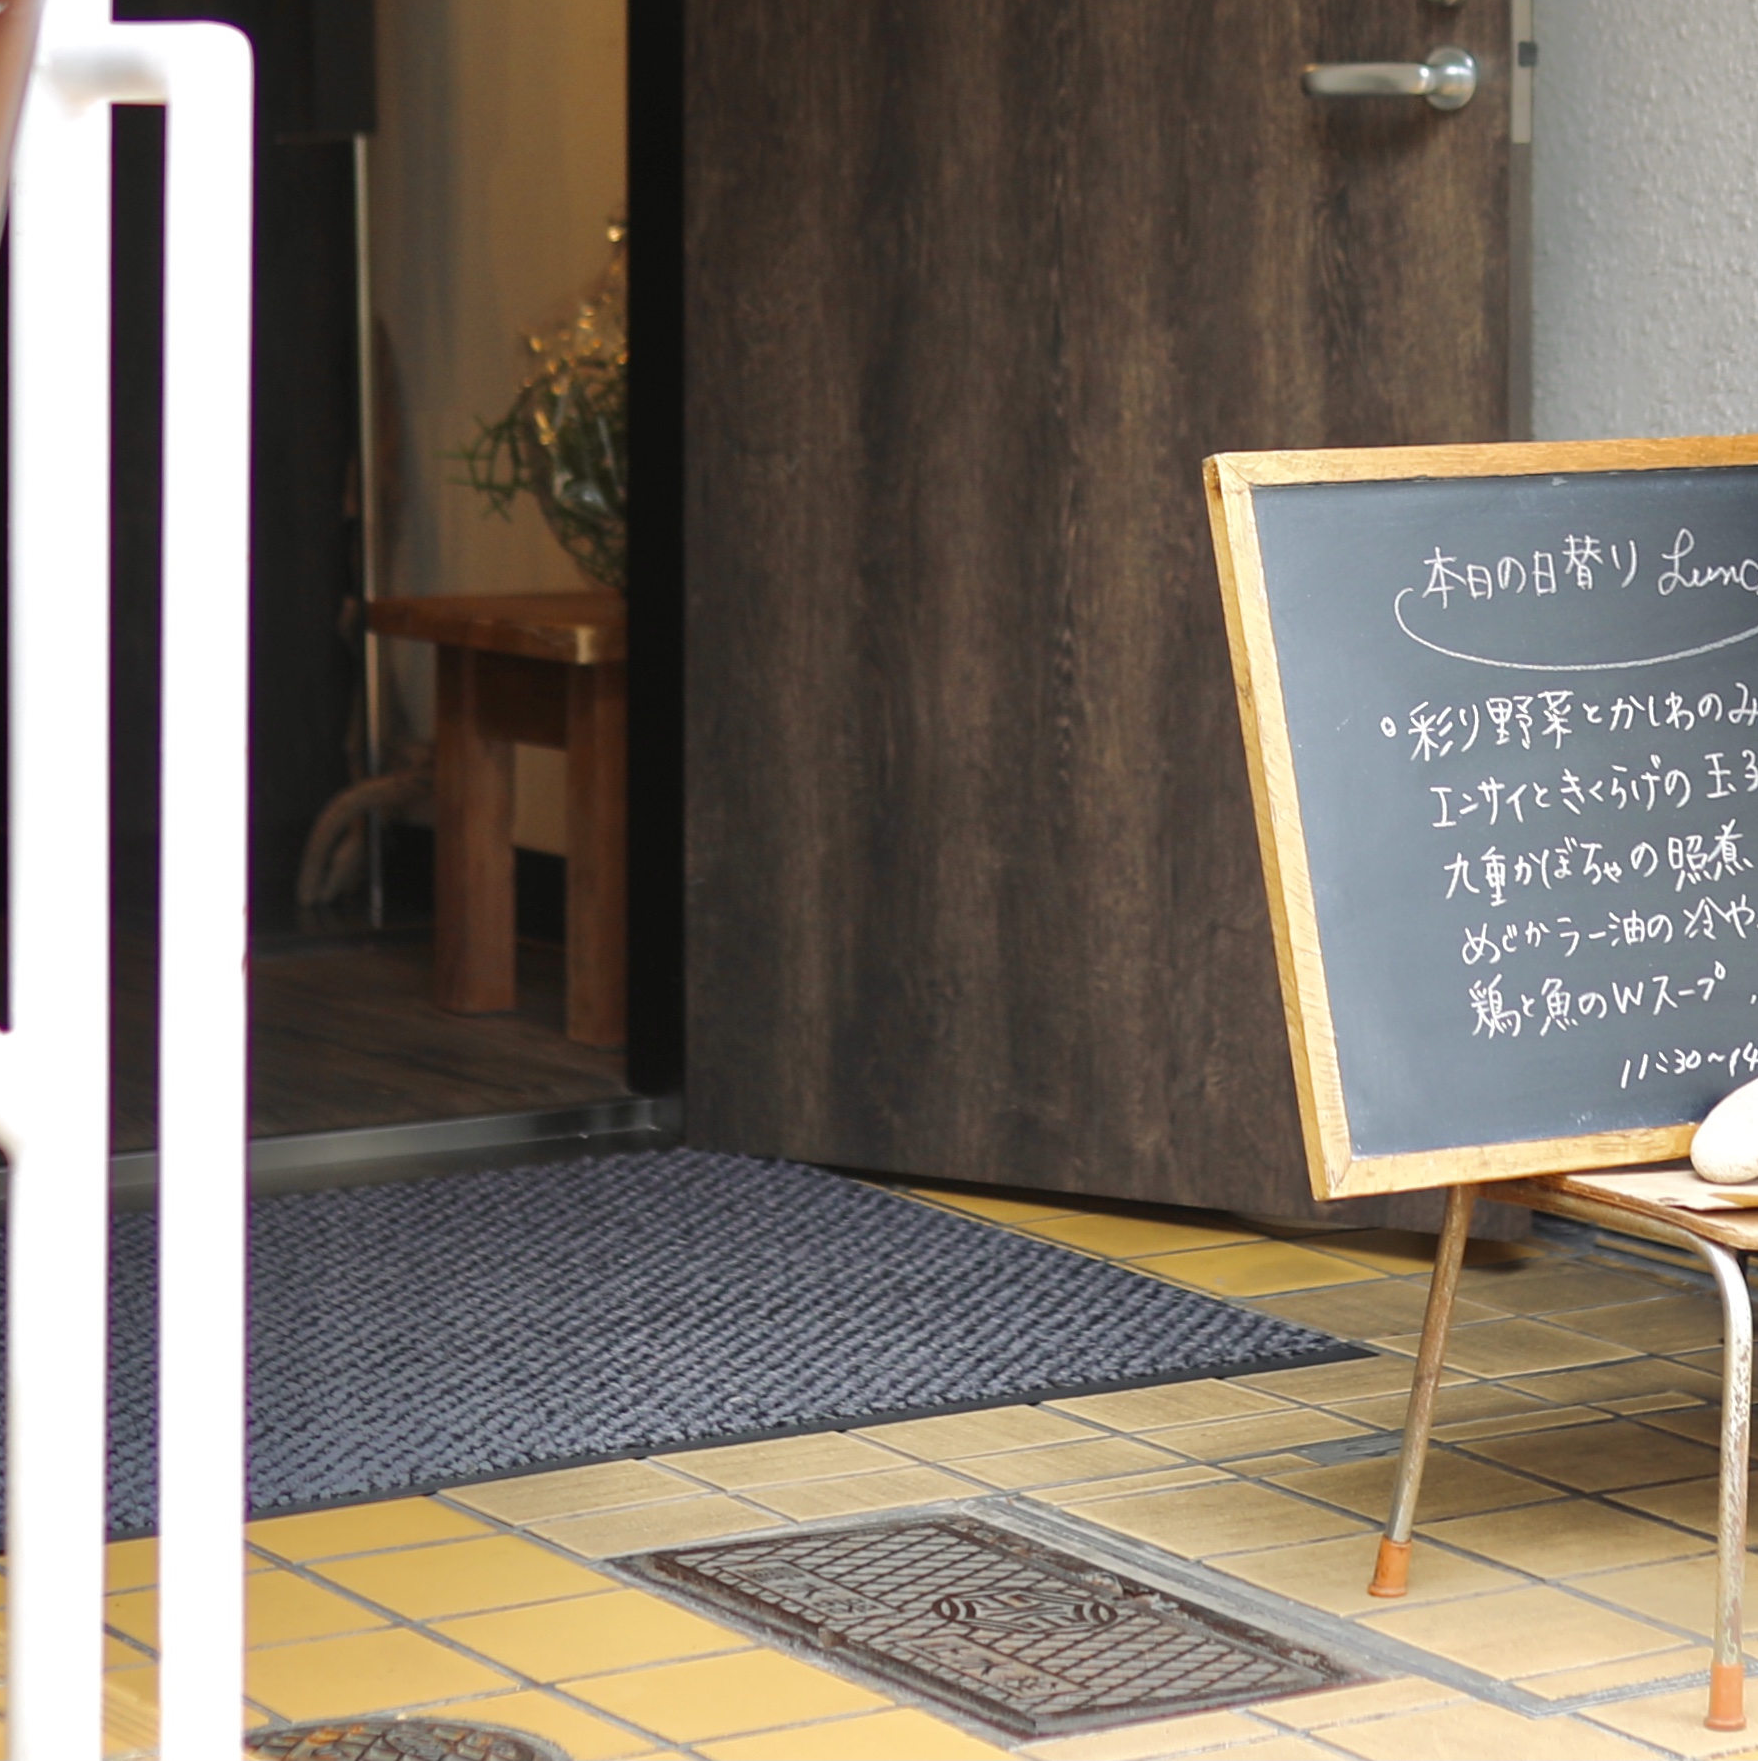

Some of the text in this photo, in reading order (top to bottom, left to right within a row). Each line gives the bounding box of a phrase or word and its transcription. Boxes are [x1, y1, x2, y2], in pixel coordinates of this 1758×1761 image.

[1421, 533, 1638, 609] 本日の日替り
